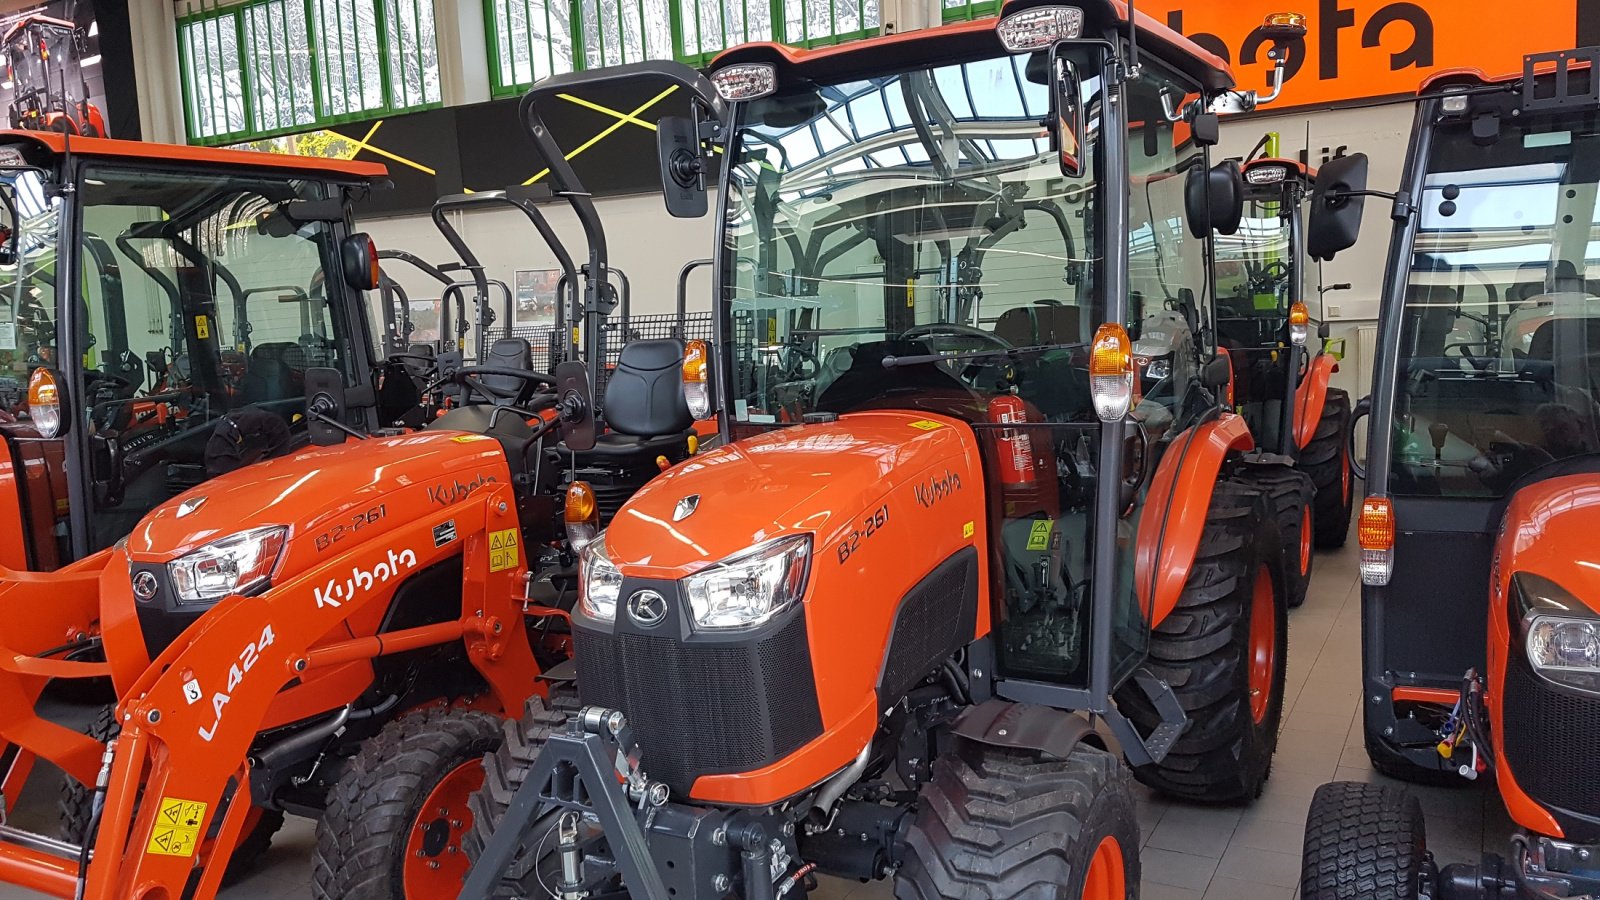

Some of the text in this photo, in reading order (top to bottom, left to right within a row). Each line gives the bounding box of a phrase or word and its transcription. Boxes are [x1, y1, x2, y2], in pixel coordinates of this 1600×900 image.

[914, 469, 961, 508] Kubota
[314, 504, 386, 552] B2-261
[837, 504, 889, 565] B2-261
[314, 548, 417, 608] Kubota
[198, 624, 275, 742] LA424
